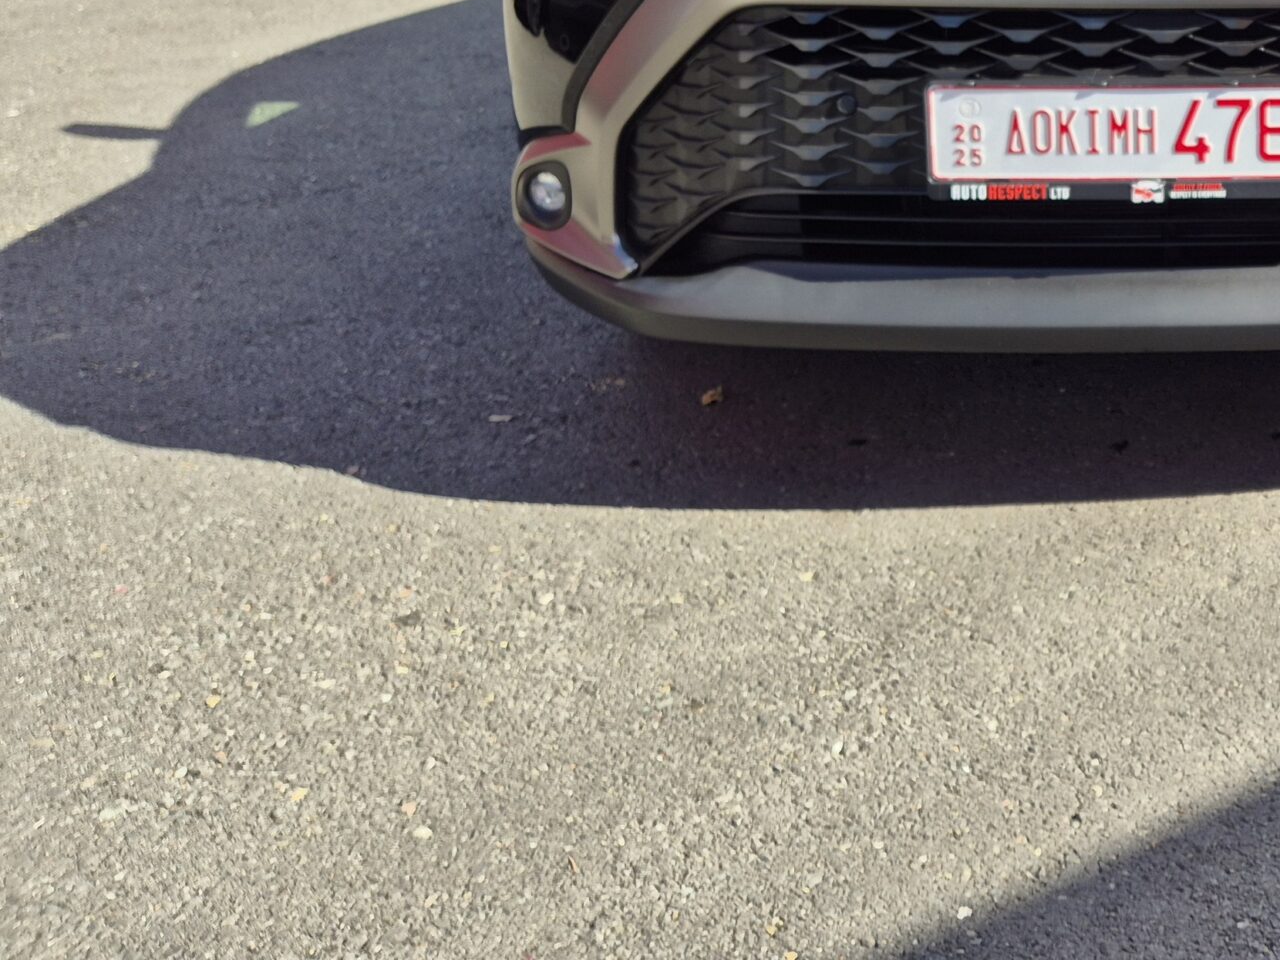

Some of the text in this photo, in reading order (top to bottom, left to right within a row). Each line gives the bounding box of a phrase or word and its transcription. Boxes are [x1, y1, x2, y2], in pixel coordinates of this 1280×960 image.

[953, 124, 982, 142] 20
[1006, 109, 1155, 155] ΔΟΚΙΜΗ
[953, 148, 982, 167] 25
[1049, 187, 1071, 200] LTD
